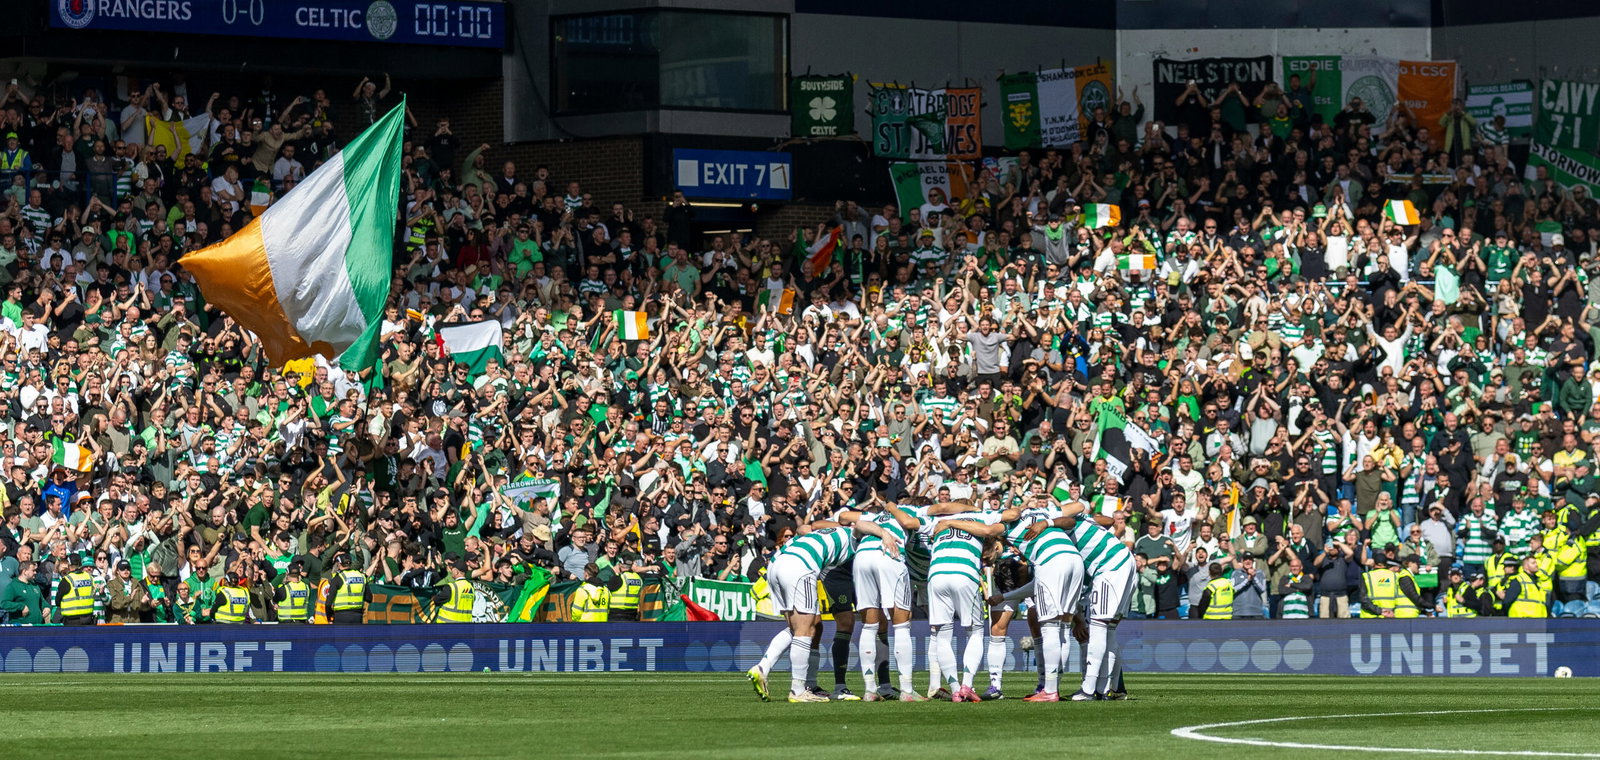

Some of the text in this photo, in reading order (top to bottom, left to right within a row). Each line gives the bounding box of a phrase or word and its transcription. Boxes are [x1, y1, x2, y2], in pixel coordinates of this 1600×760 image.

[98, 0, 192, 20] RANGERS
[222, 0, 264, 25] 0-0
[295, 7, 362, 28] CELTIC
[415, 4, 491, 38] 00:00
[1160, 60, 1266, 83] NEILSTON
[1290, 60, 1334, 71] EDDIE
[1420, 66, 1449, 76] CSC
[800, 80, 844, 91] SOUTHSIDE
[1542, 80, 1600, 116] CAVY
[878, 92, 976, 117] COATBRDGE
[810, 126, 837, 136] CELTIC
[879, 122, 909, 153] ST.
[704, 163, 766, 185] EXIT 7
[897, 165, 970, 184] MICHAEL DAVI
[1532, 142, 1600, 184] STORNOW
[925, 176, 945, 185] CSC
[502, 479, 551, 491] BARROWFIELD
[473, 582, 504, 608] BRIGADE
[695, 587, 756, 621] AHOY!
[114, 642, 292, 673] UNIBET
[498, 638, 664, 672] UNIBET
[1350, 632, 1555, 674] UNIBET
